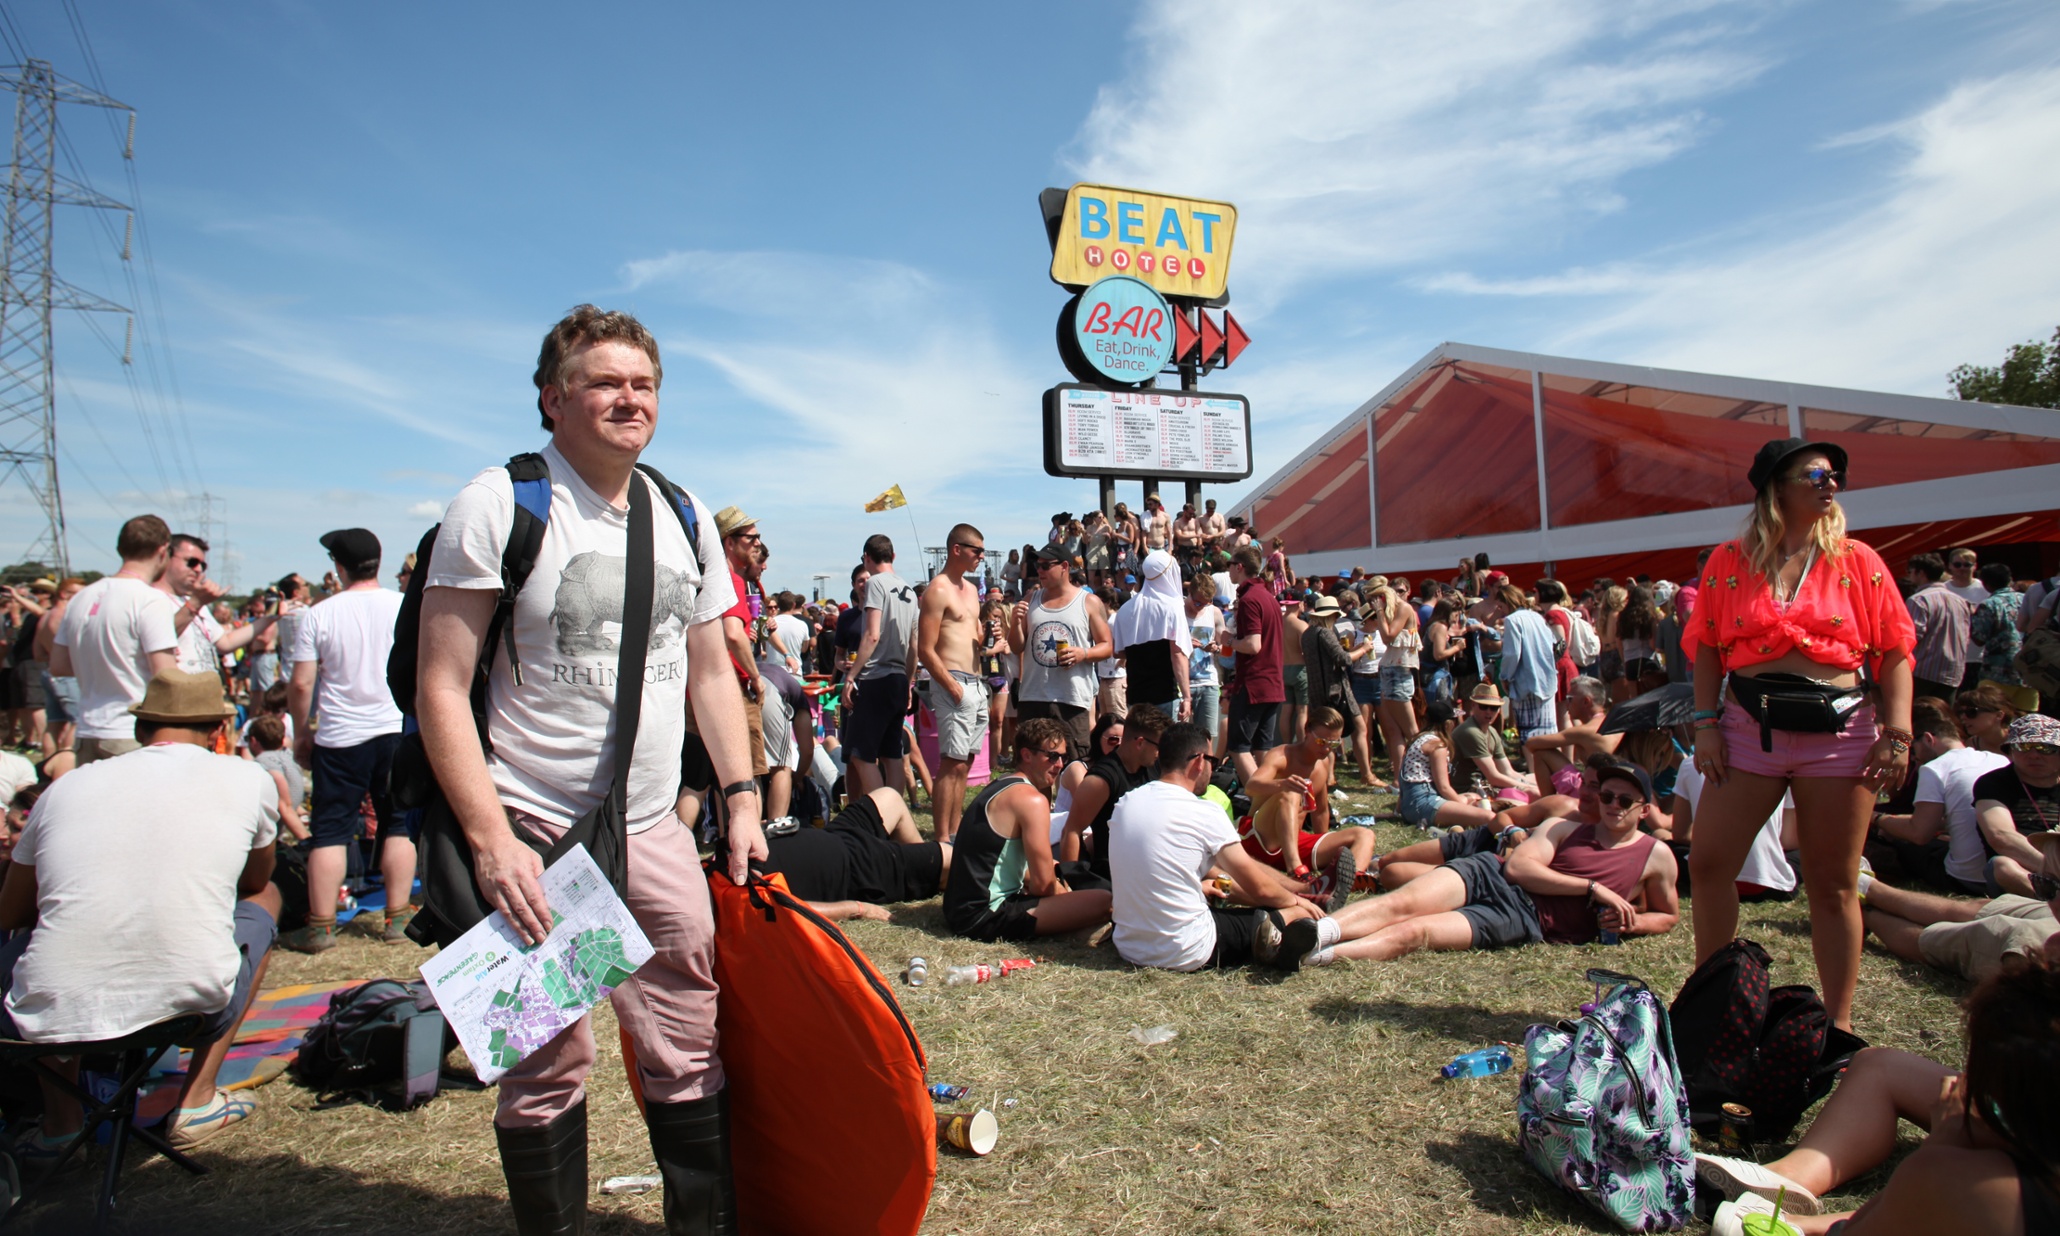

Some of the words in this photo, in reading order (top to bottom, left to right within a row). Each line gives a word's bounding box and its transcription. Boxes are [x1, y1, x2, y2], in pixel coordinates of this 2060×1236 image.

[1079, 196, 1221, 254] BEAT
[1087, 248, 1203, 276] HOTEL
[1083, 302, 1163, 342] BAR
[1096, 339, 1121, 356] Eat,
[1122, 341, 1161, 361] Drink,
[1104, 355, 1149, 372] Dance.
[1111, 392, 1161, 405] LINE
[1174, 396, 1202, 408] UP
[1037, 625, 1069, 640] CONVERSE
[462, 960, 485, 976] Oxfam
[475, 955, 509, 982] WaterAid
